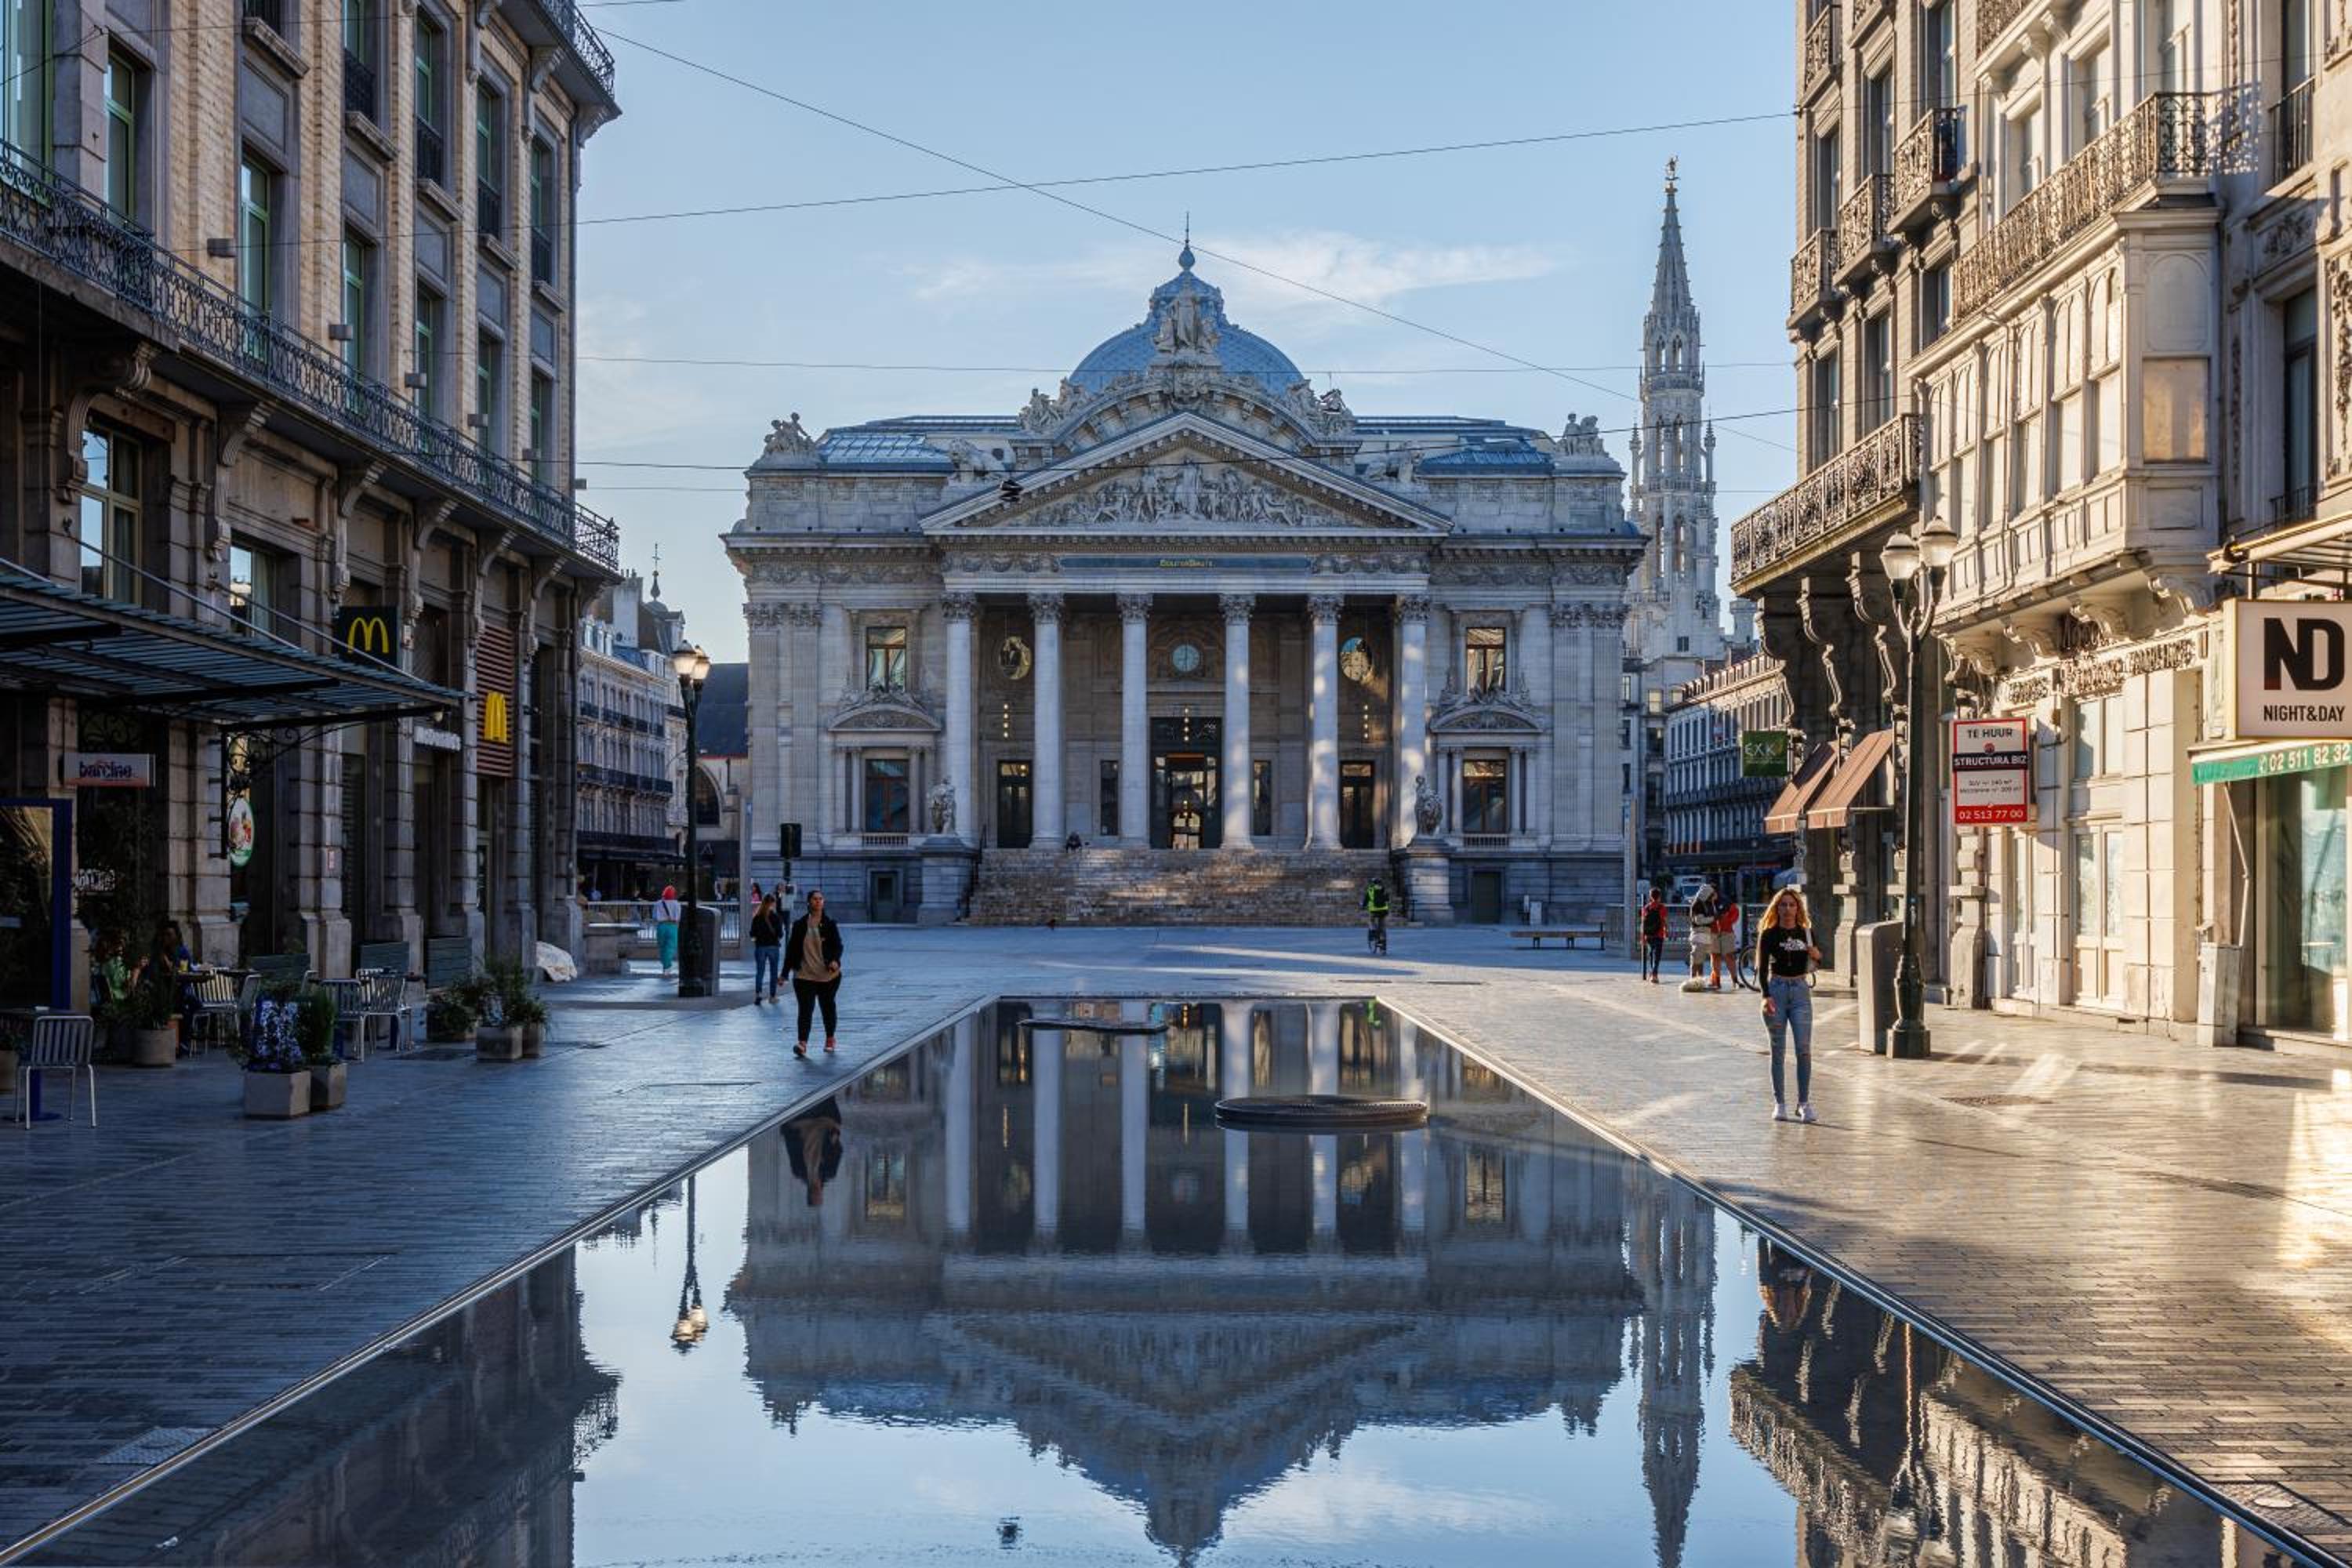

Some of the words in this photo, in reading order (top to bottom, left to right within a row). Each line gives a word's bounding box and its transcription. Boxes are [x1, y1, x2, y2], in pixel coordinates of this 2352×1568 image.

[2264, 618, 2345, 691] ND
[2264, 705, 2346, 722] NIGHT&DAY
[1968, 728, 1979, 739] TE
[1982, 728, 2013, 738] HUUR
[2269, 753, 2284, 771] 02
[2288, 749, 2308, 768] 511
[2314, 746, 2329, 766] 82
[2333, 742, 2350, 762] 32
[1959, 811, 1972, 819] 02
[1974, 810, 1992, 819] 513
[1995, 810, 2008, 818] 77
[2009, 809, 2024, 818] 00
